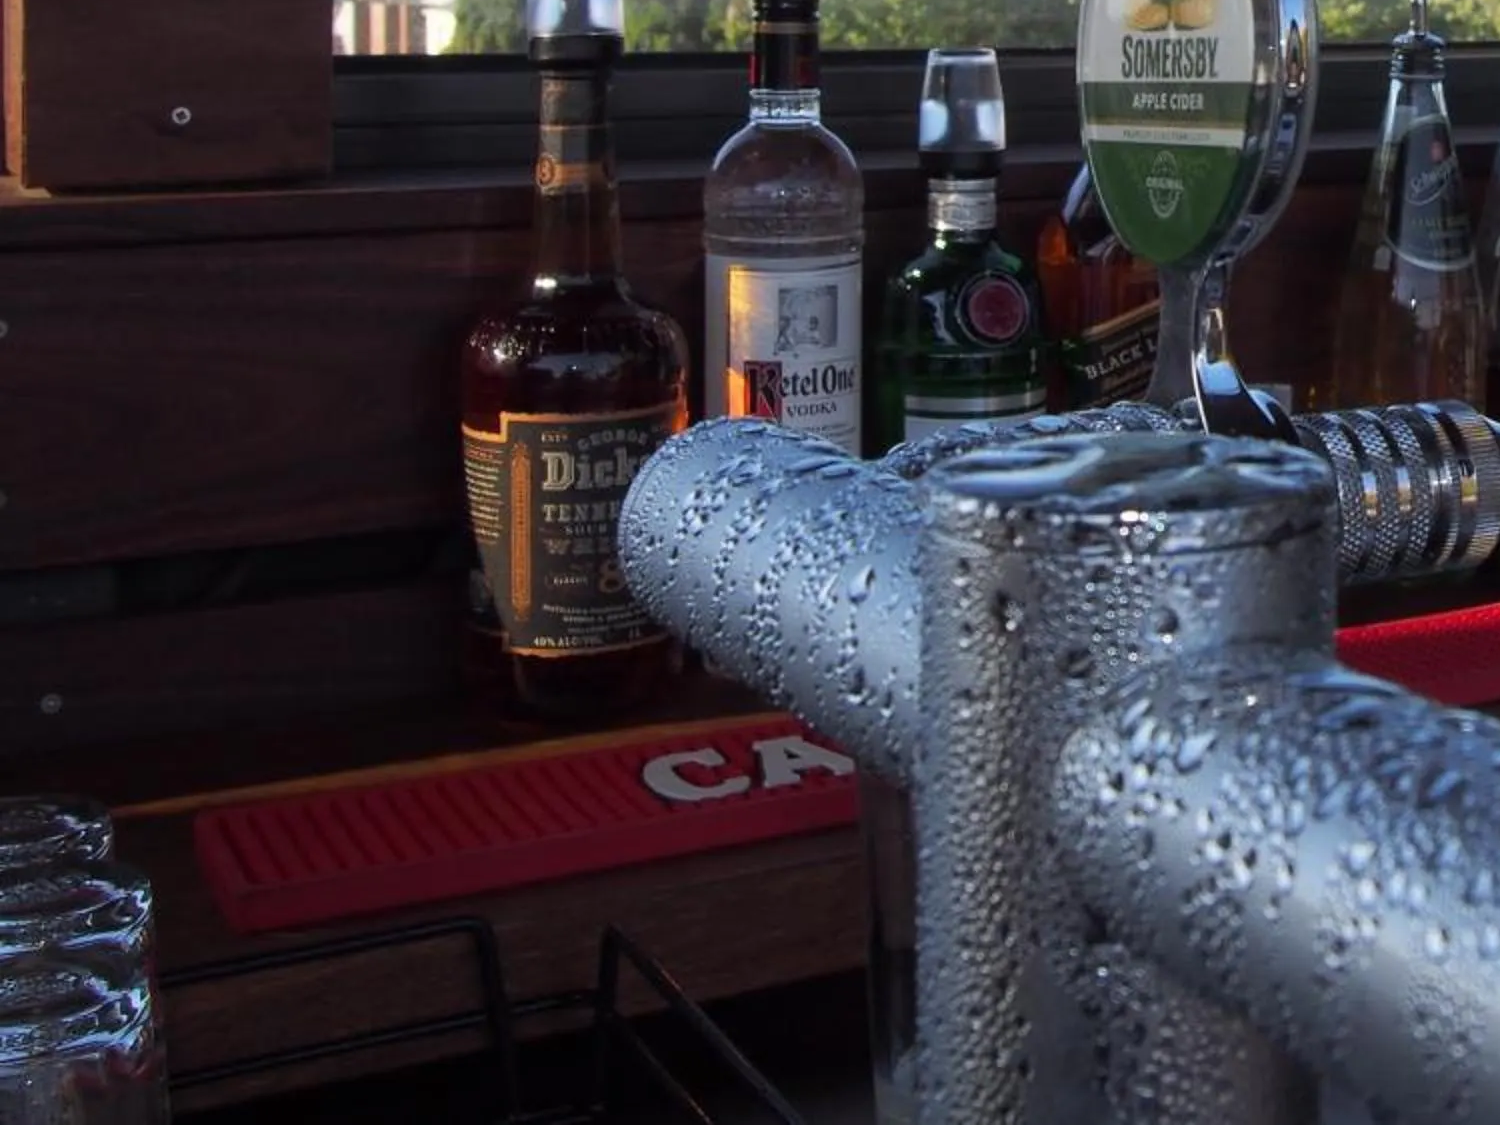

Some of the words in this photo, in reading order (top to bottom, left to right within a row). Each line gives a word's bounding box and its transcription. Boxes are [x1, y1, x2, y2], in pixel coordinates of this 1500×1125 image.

[1121, 34, 1220, 79] SOMERSBY
[1131, 92, 1167, 110] APPLE
[1169, 92, 1205, 111] CIDER
[1084, 343, 1145, 379] BLACK
[745, 362, 819, 425] Ketel
[821, 363, 856, 396] One
[786, 400, 838, 419] VODKA
[540, 445, 647, 492] Dick
